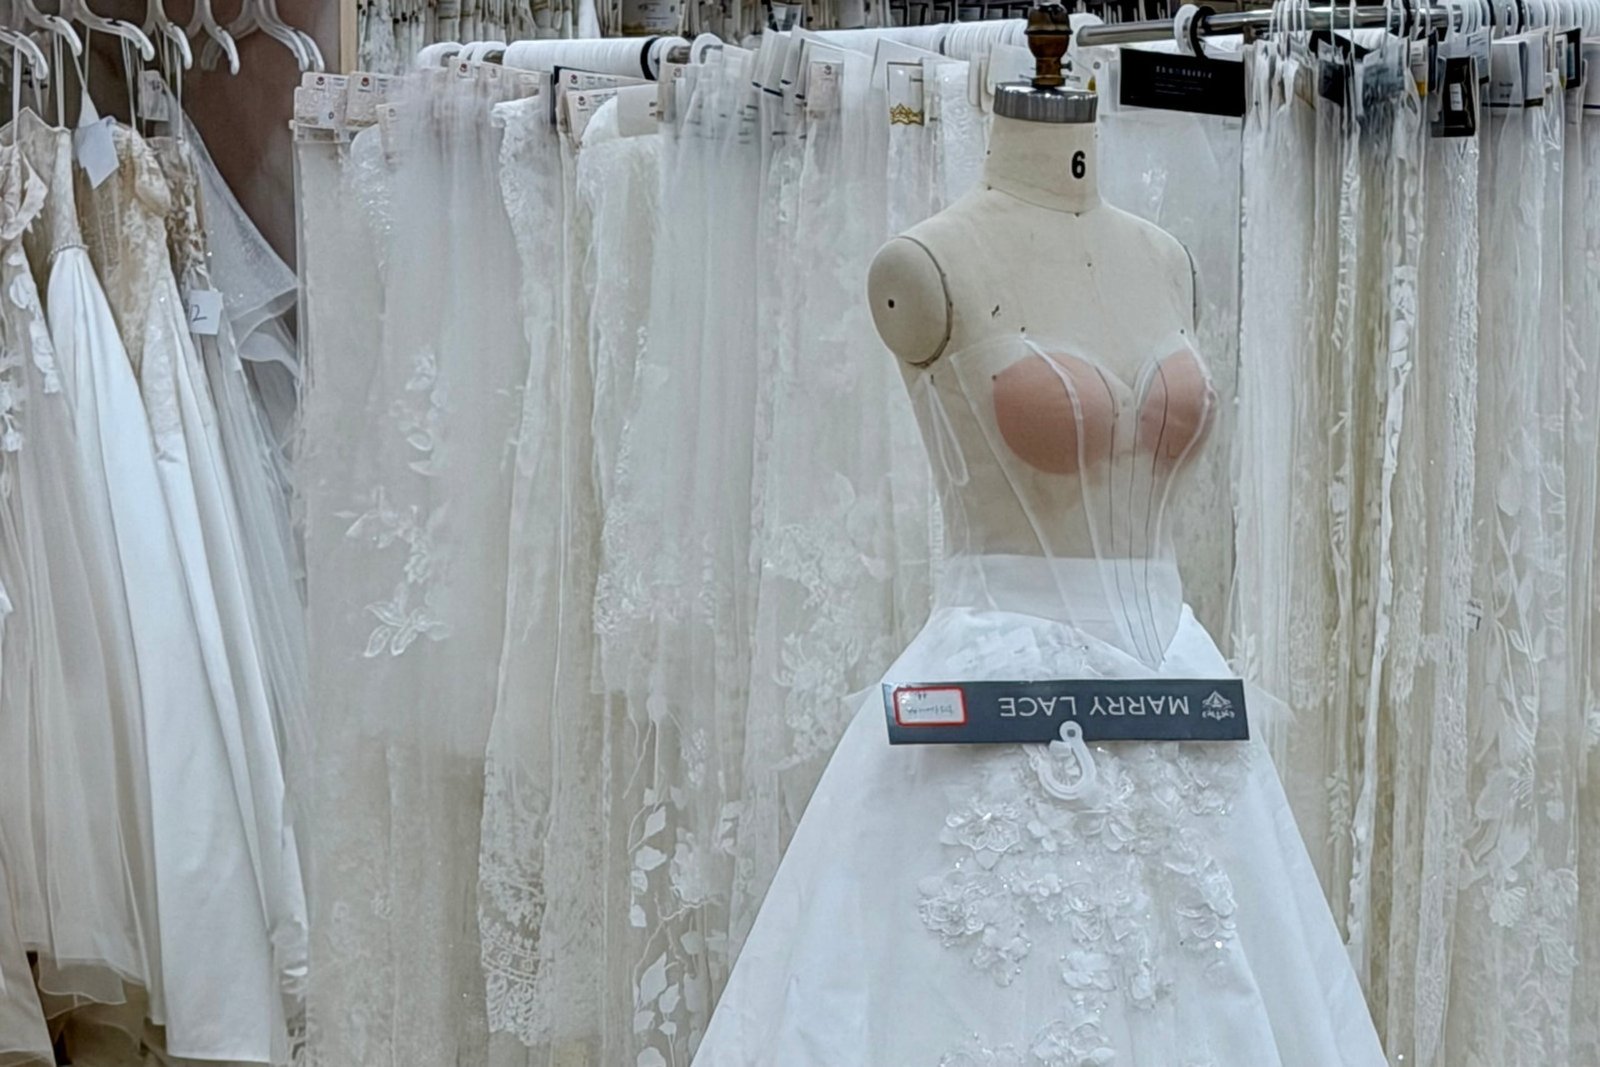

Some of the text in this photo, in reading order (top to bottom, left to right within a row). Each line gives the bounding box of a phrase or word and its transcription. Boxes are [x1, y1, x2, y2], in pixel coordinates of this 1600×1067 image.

[1072, 150, 1086, 180] 6
[998, 695, 1190, 718] MARRY LACE
